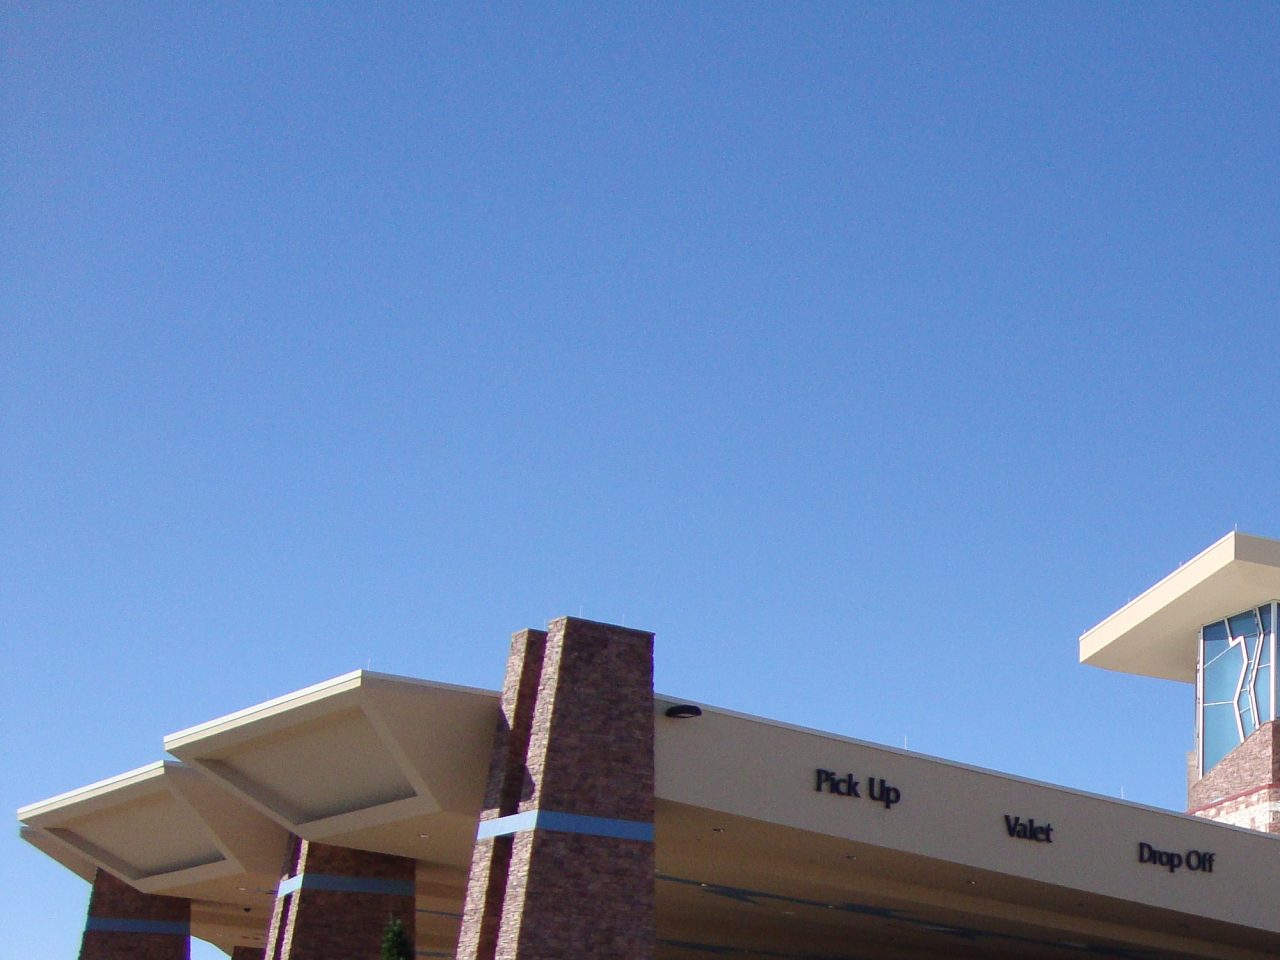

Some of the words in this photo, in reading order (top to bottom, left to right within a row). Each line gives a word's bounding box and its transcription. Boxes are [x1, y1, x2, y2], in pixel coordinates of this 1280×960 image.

[815, 768, 861, 799] Pick
[867, 776, 901, 809] Up
[1004, 814, 1054, 843] Valet
[1138, 842, 1183, 873] Drop
[1185, 850, 1216, 873] Off
